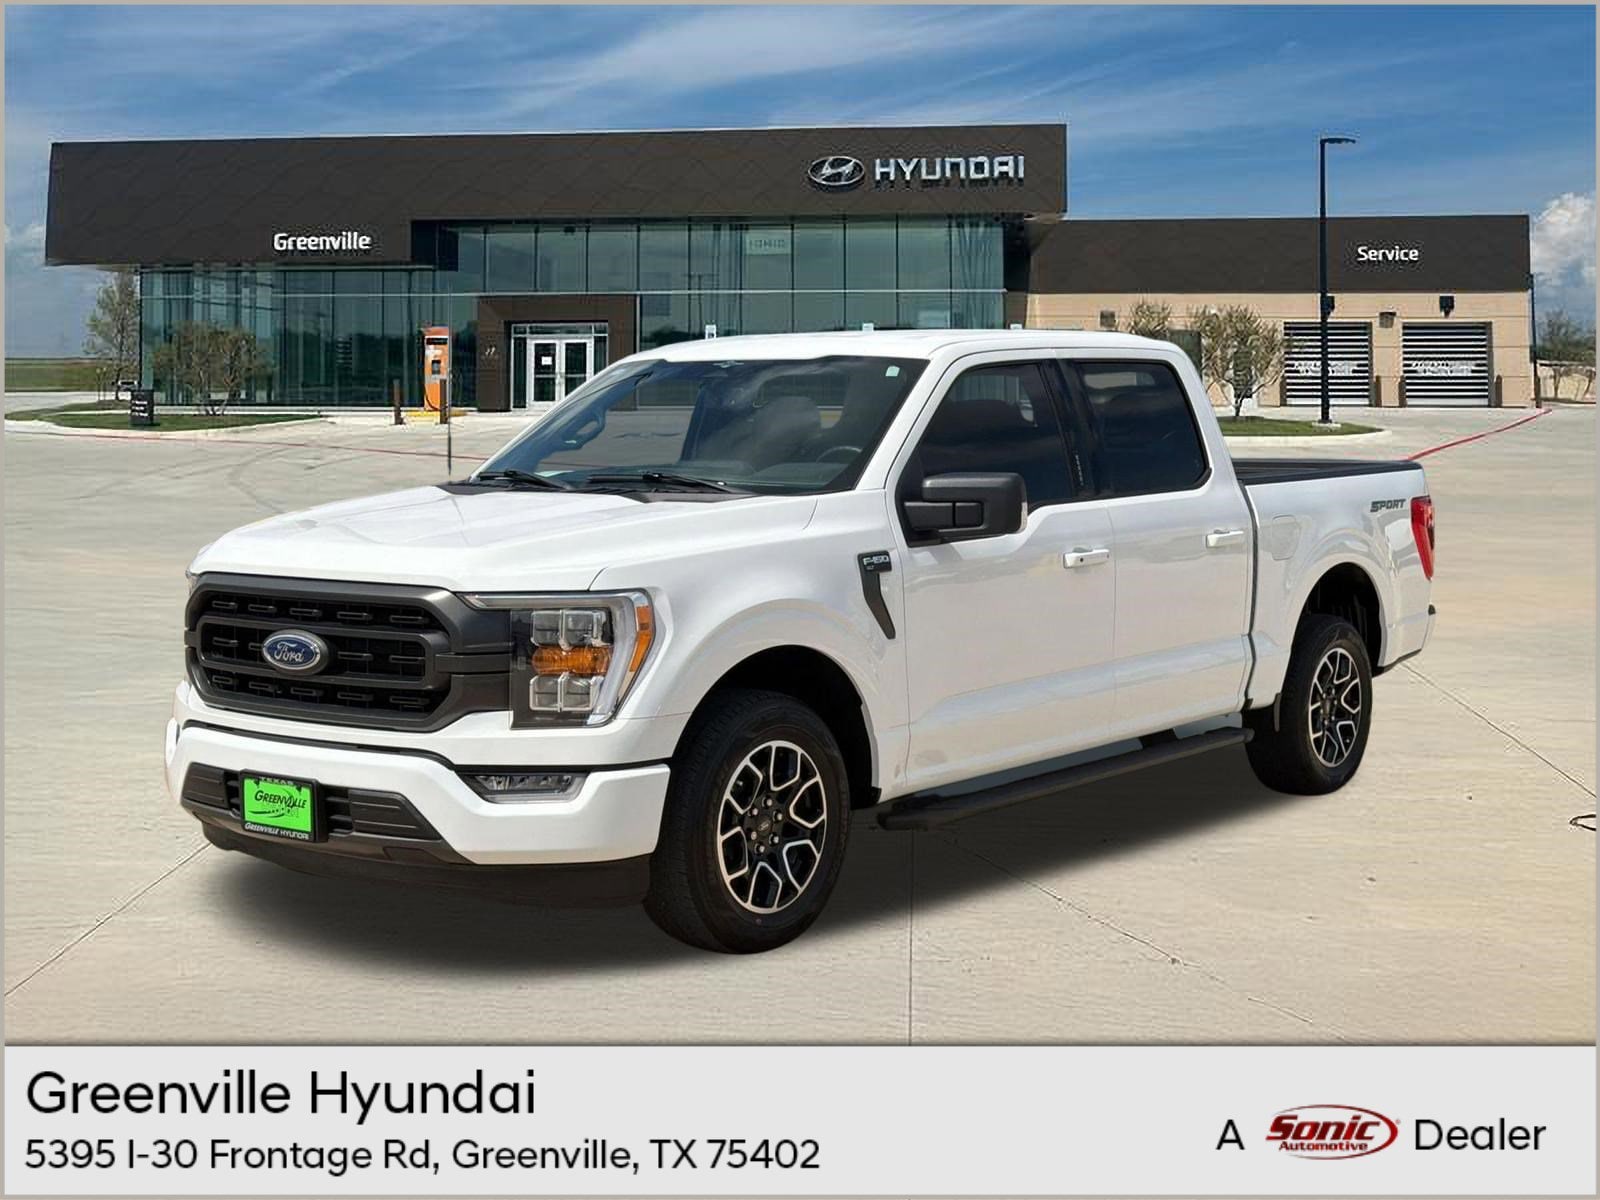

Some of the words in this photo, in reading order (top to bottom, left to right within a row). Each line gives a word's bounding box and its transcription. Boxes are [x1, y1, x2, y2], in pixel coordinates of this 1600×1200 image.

[874, 155, 1025, 181] HYUNDAI
[273, 231, 372, 251] Greenville
[1357, 245, 1419, 261] Service
[1370, 498, 1406, 513] SPORT
[274, 641, 305, 663] Ford
